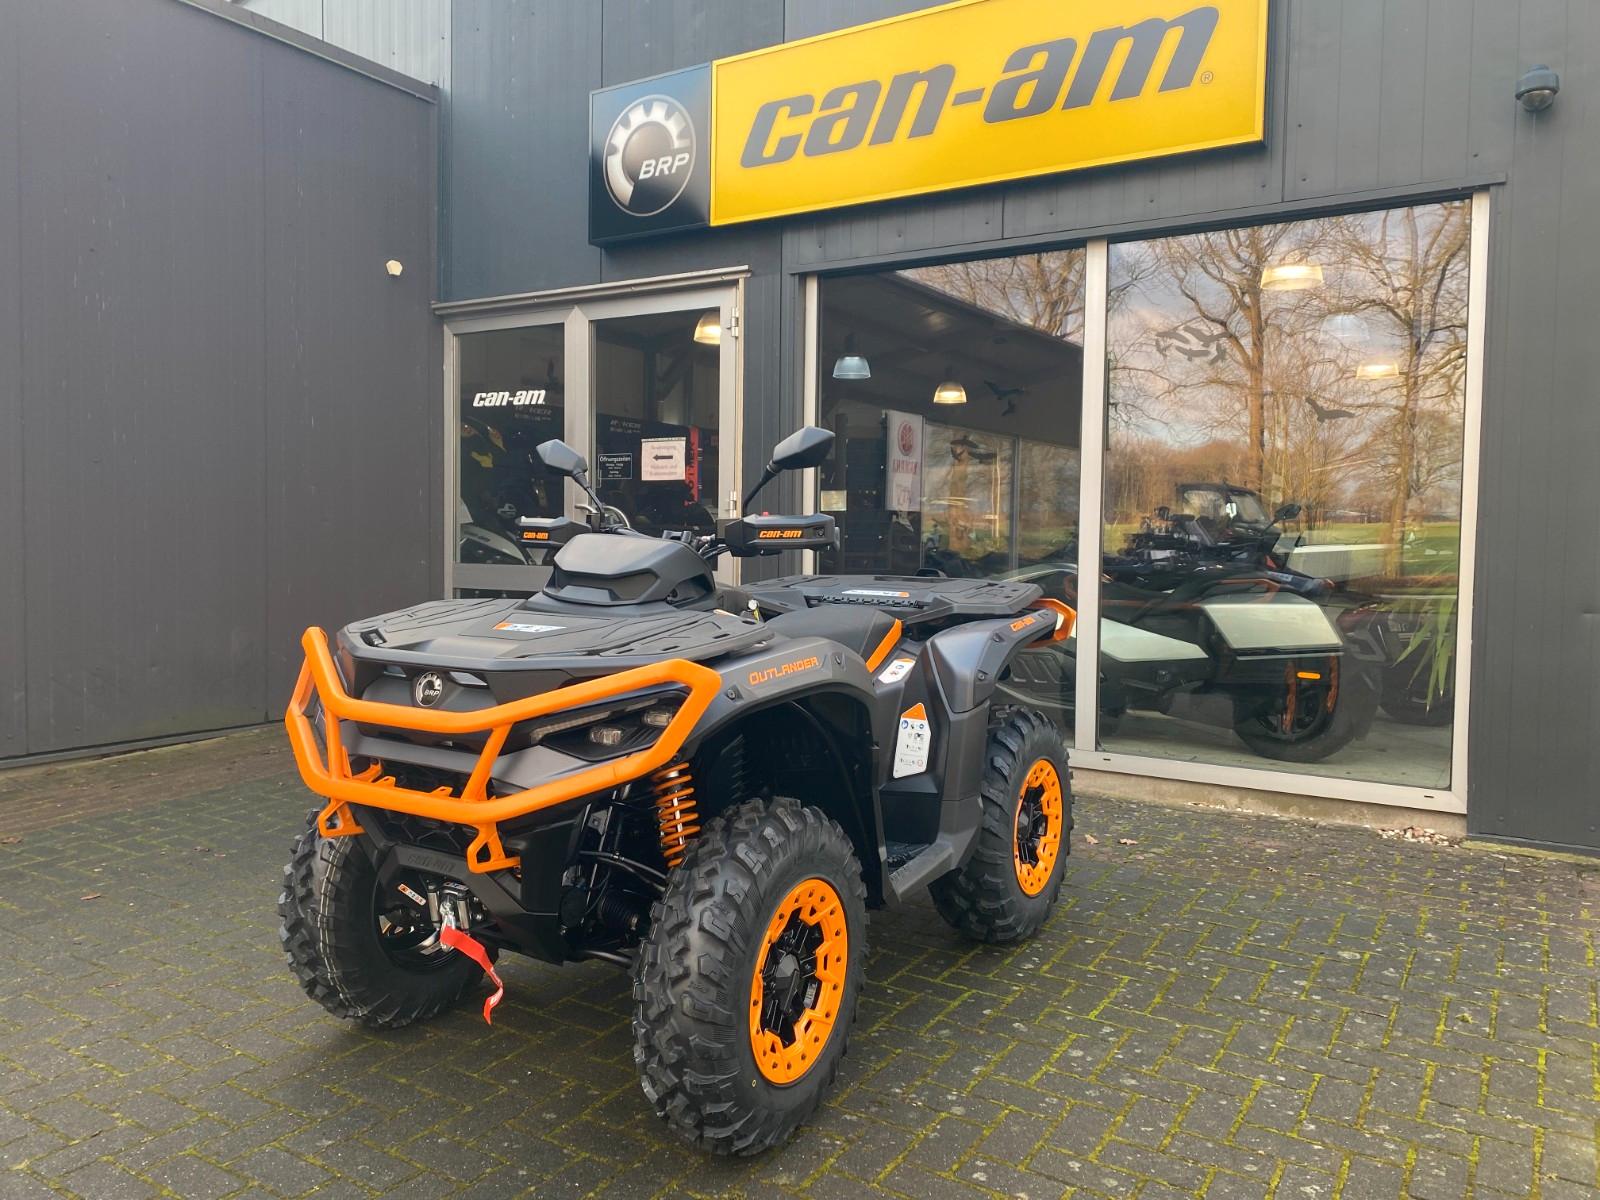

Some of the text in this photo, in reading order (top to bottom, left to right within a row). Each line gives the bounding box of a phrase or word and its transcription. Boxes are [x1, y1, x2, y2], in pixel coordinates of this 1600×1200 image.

[639, 152, 690, 180] BRP
[472, 390, 546, 407] can-am
[759, 530, 803, 538] can-am
[749, 656, 819, 686] OUTLANDER
[424, 689, 440, 697] BRP
